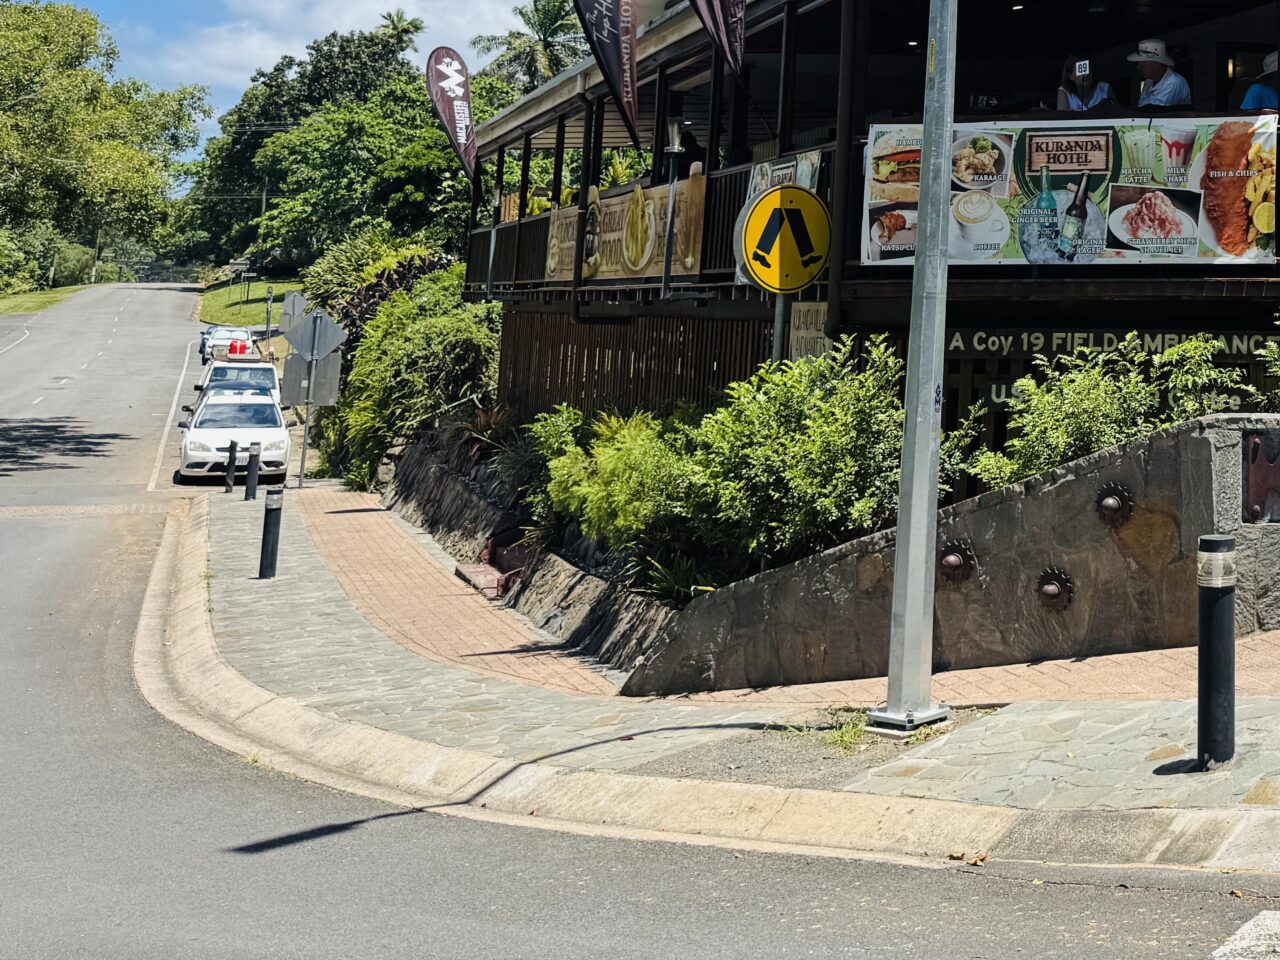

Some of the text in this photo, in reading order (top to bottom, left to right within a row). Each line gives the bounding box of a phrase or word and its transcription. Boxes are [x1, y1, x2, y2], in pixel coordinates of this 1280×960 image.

[593, 16, 618, 43] Tap
[621, 34, 633, 102] KURANDA
[1078, 62, 1088, 73] 89
[453, 100, 467, 144] MACALISTER
[1034, 140, 1103, 153] KURANDA
[1047, 153, 1092, 165] HOTEL
[1121, 167, 1153, 175] MATCHA
[1210, 170, 1227, 178] FISH
[974, 174, 1007, 182] KARAAGE
[1164, 175, 1189, 183] SHAKE
[602, 209, 625, 233] GREAT
[601, 238, 622, 265] FOOD
[881, 243, 905, 251] KATSU
[973, 242, 1001, 251] COFFEE
[1078, 246, 1101, 254] LAGER
[1140, 246, 1184, 254] SHAVED ICE
[948, 332, 965, 351] A
[1021, 332, 1045, 351] 19
[1052, 333, 1119, 353] FIELD
